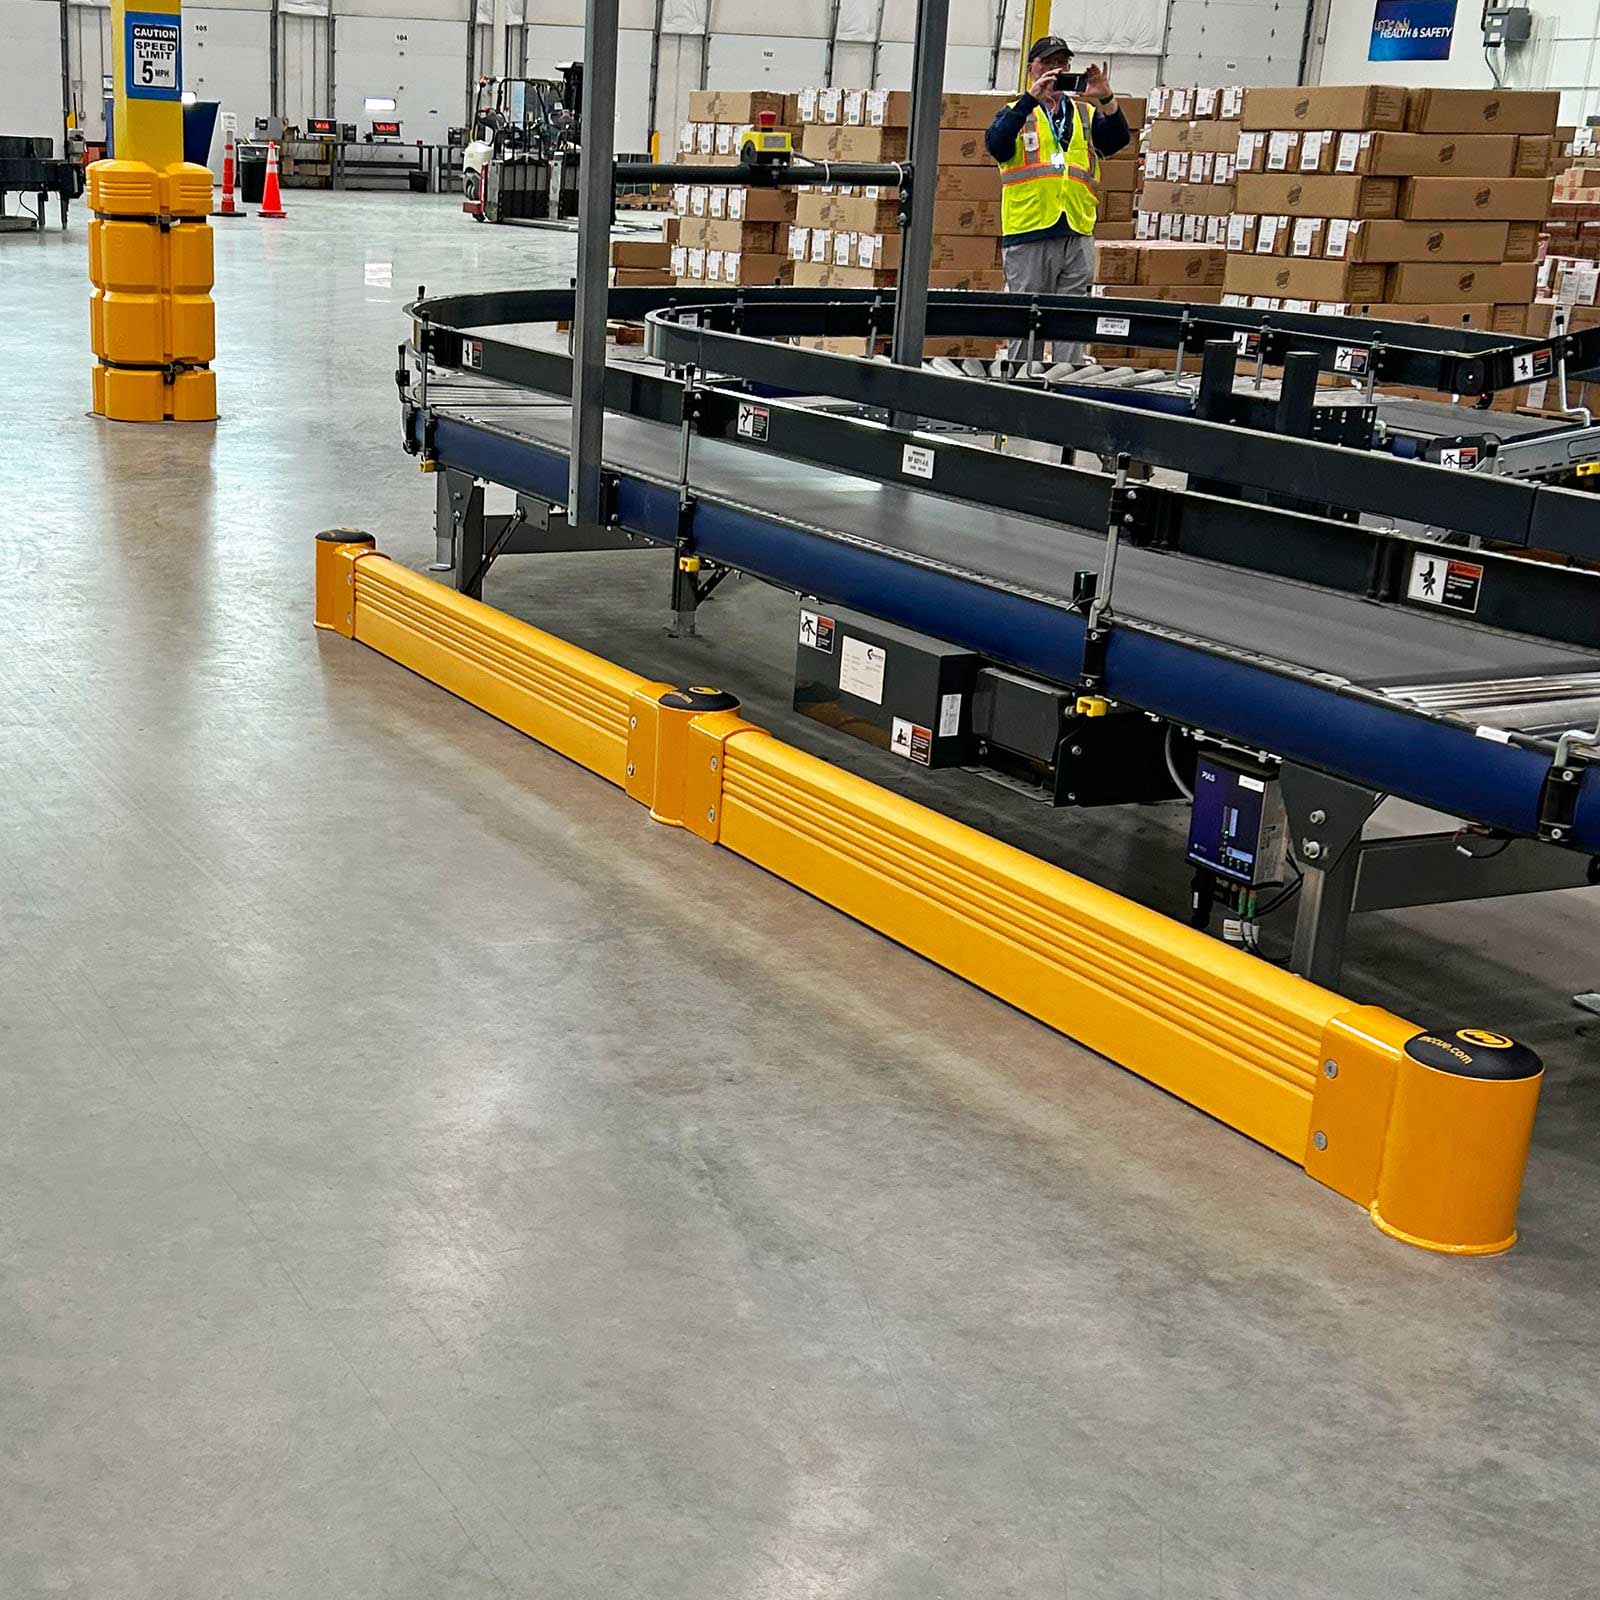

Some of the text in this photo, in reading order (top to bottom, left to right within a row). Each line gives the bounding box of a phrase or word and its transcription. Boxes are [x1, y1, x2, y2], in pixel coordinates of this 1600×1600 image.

[134, 28, 176, 39] CAUTION
[1380, 26, 1452, 38] HEALTH & SAFETY
[135, 41, 175, 52] SPEED
[138, 50, 172, 60] LIMIT
[141, 60, 170, 84] 5 MPH
